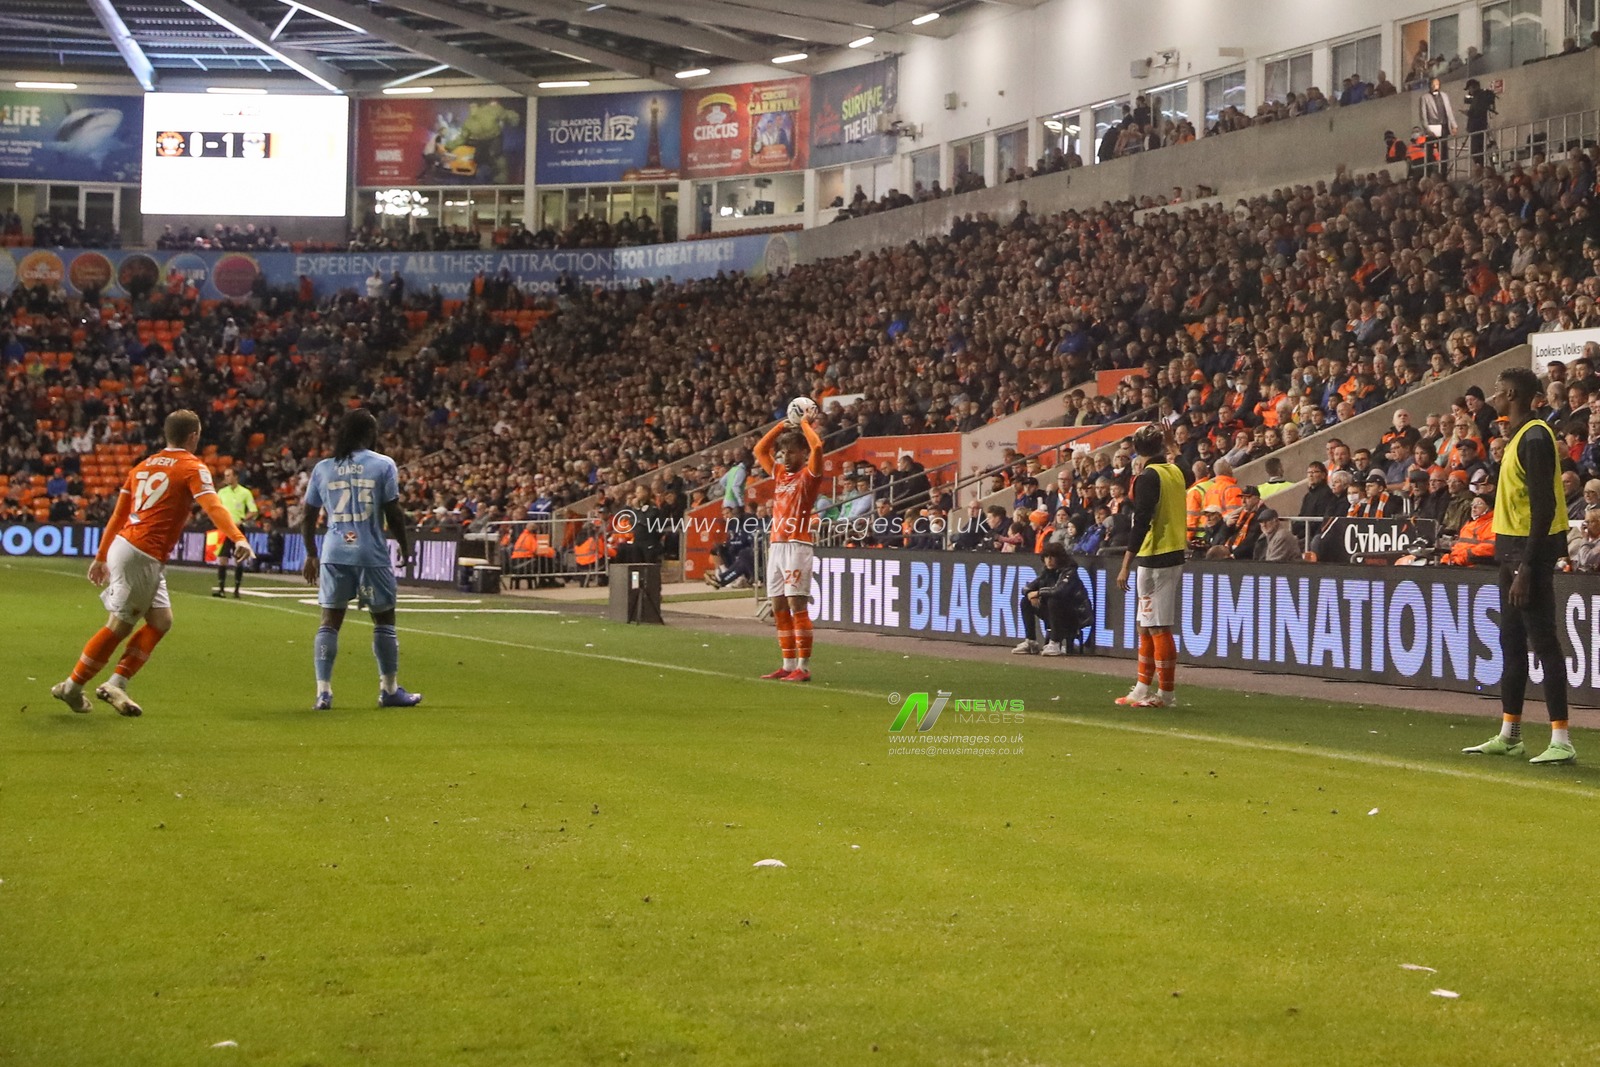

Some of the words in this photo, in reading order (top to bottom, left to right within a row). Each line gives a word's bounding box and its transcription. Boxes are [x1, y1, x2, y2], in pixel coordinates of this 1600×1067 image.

[548, 126, 601, 144] TOWER
[610, 124, 635, 141] 125
[560, 118, 602, 127] BLACKPOOL
[693, 122, 739, 141] CIRCUS
[843, 119, 862, 143] THE
[295, 255, 400, 275] EXPERIENCE
[403, 255, 438, 274] ALL
[442, 253, 494, 273] THESE
[499, 252, 620, 273] ATTRACTIONS
[620, 251, 645, 269] FOR
[655, 244, 693, 264] GREAT
[1536, 345, 1562, 357] Lookers
[134, 471, 170, 513] 19
[328, 478, 376, 523] 23
[0, 524, 80, 556] OOL
[784, 569, 802, 595] 29
[850, 557, 901, 628] THE
[909, 560, 1116, 648] BLACKPL
[1123, 568, 1504, 686] IUMINATIONS
